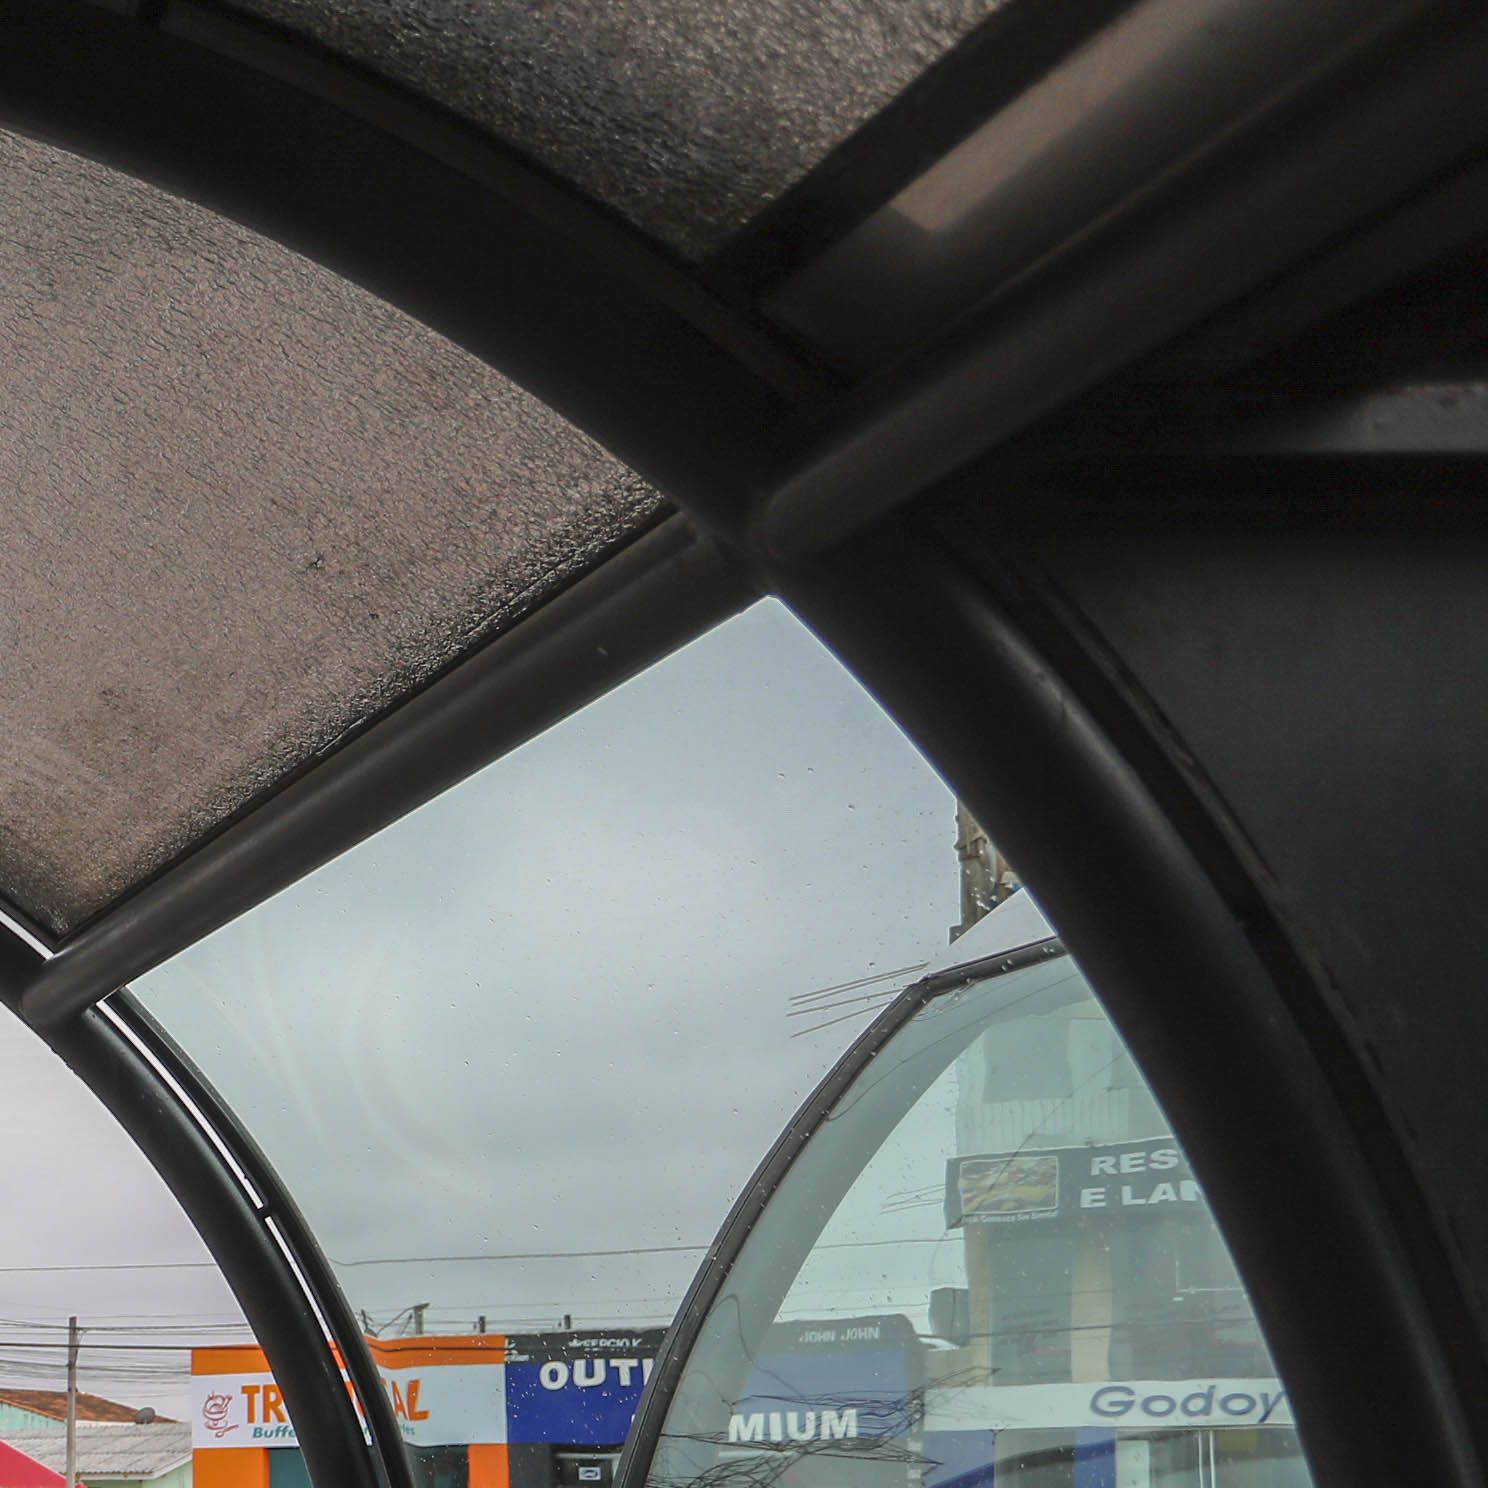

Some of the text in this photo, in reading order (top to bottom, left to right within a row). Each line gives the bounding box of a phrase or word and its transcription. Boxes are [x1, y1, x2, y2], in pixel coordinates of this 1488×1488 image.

[1090, 1149, 1179, 1176] RES
[1080, 1187, 1107, 1208] E
[252, 1424, 297, 1439] Buffe
